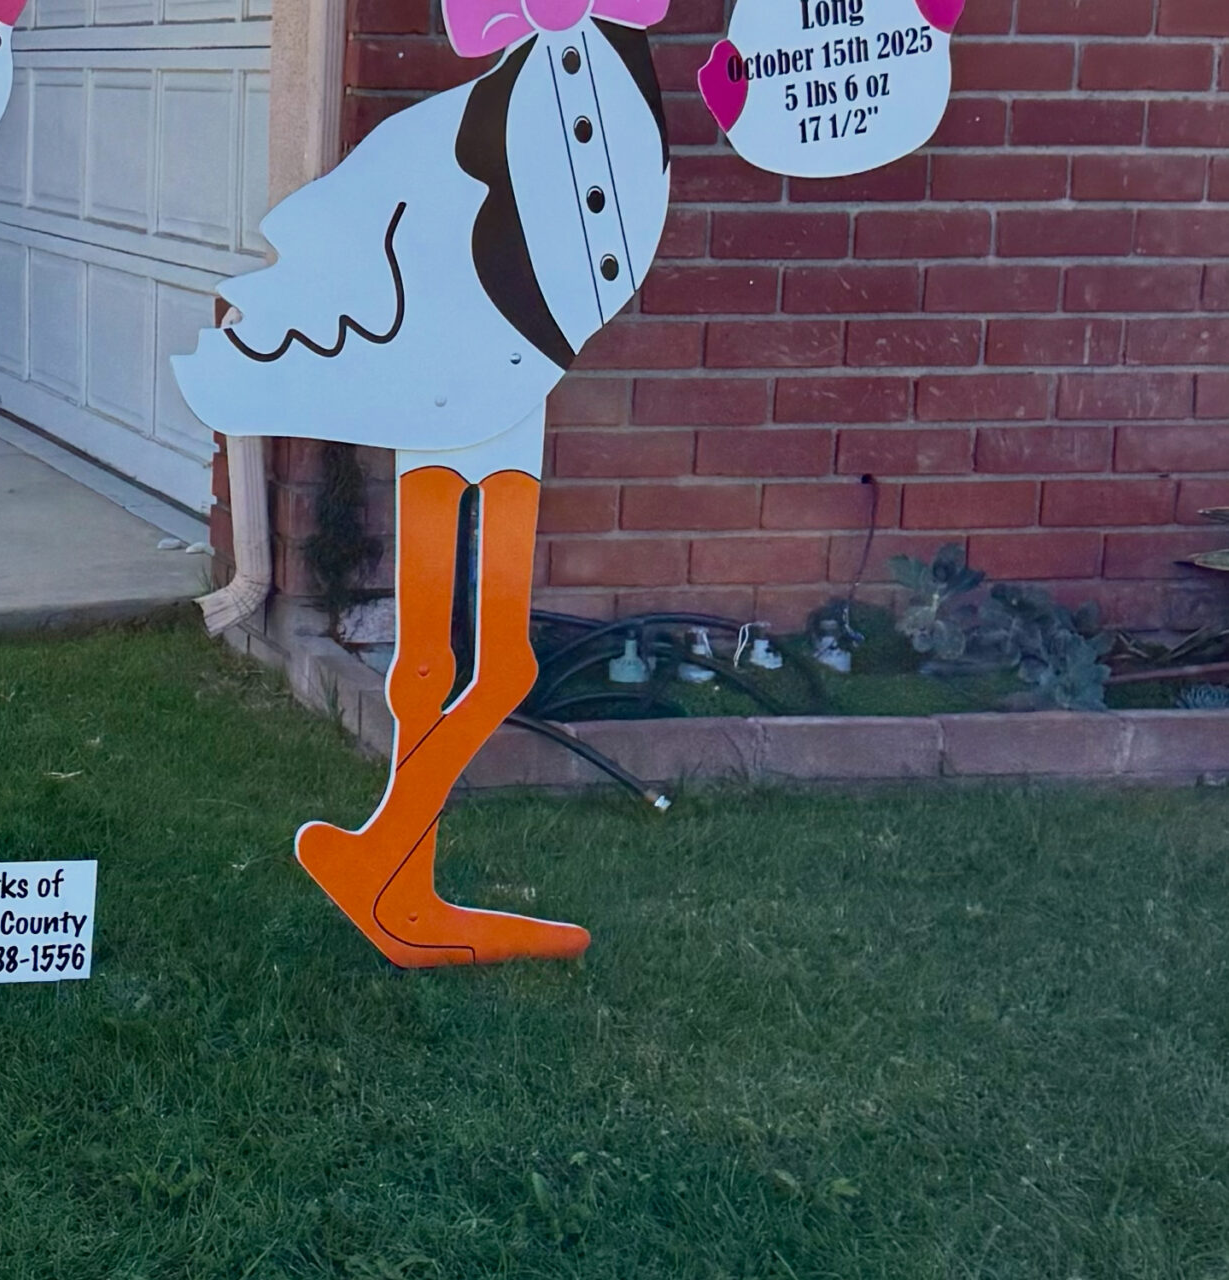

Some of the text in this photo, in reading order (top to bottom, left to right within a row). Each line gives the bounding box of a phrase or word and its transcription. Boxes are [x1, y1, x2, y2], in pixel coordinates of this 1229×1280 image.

[727, 25, 933, 83] October 15th 2025
[785, 72, 890, 111] 5 lbs 6 oz
[798, 106, 879, 144] 17 1/2"
[37, 868, 65, 898] of
[0, 910, 88, 938] County
